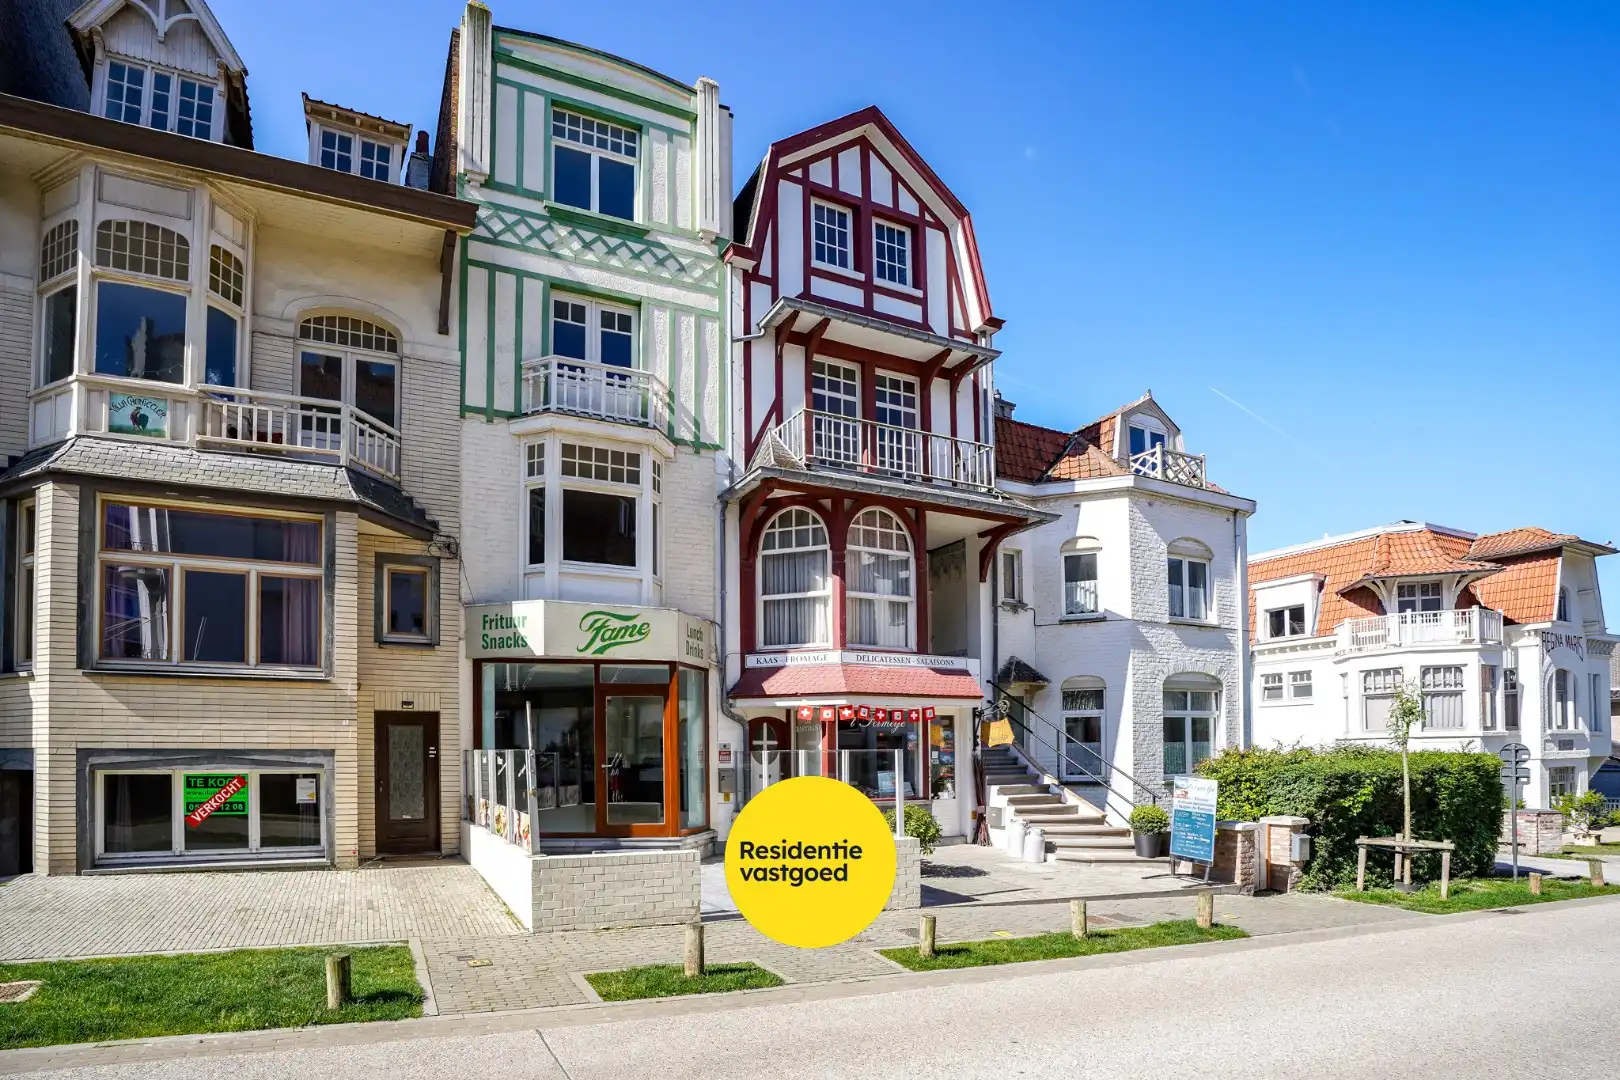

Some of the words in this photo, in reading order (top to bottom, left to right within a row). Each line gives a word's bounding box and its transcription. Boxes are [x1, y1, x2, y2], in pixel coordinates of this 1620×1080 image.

[482, 613, 528, 630] Frituur
[576, 610, 650, 655] Fame
[686, 622, 703, 641] Lunch
[481, 632, 528, 650] Snacks
[686, 640, 703, 659] Drinks
[1541, 631, 1564, 652] REGINA
[756, 656, 778, 665] KAAS
[785, 654, 828, 663] FROMAGE
[856, 654, 911, 665] DELICATESSEN
[916, 657, 955, 666] SALAISONS
[189, 778, 204, 787] TE
[191, 779, 241, 821] VERKOCHT
